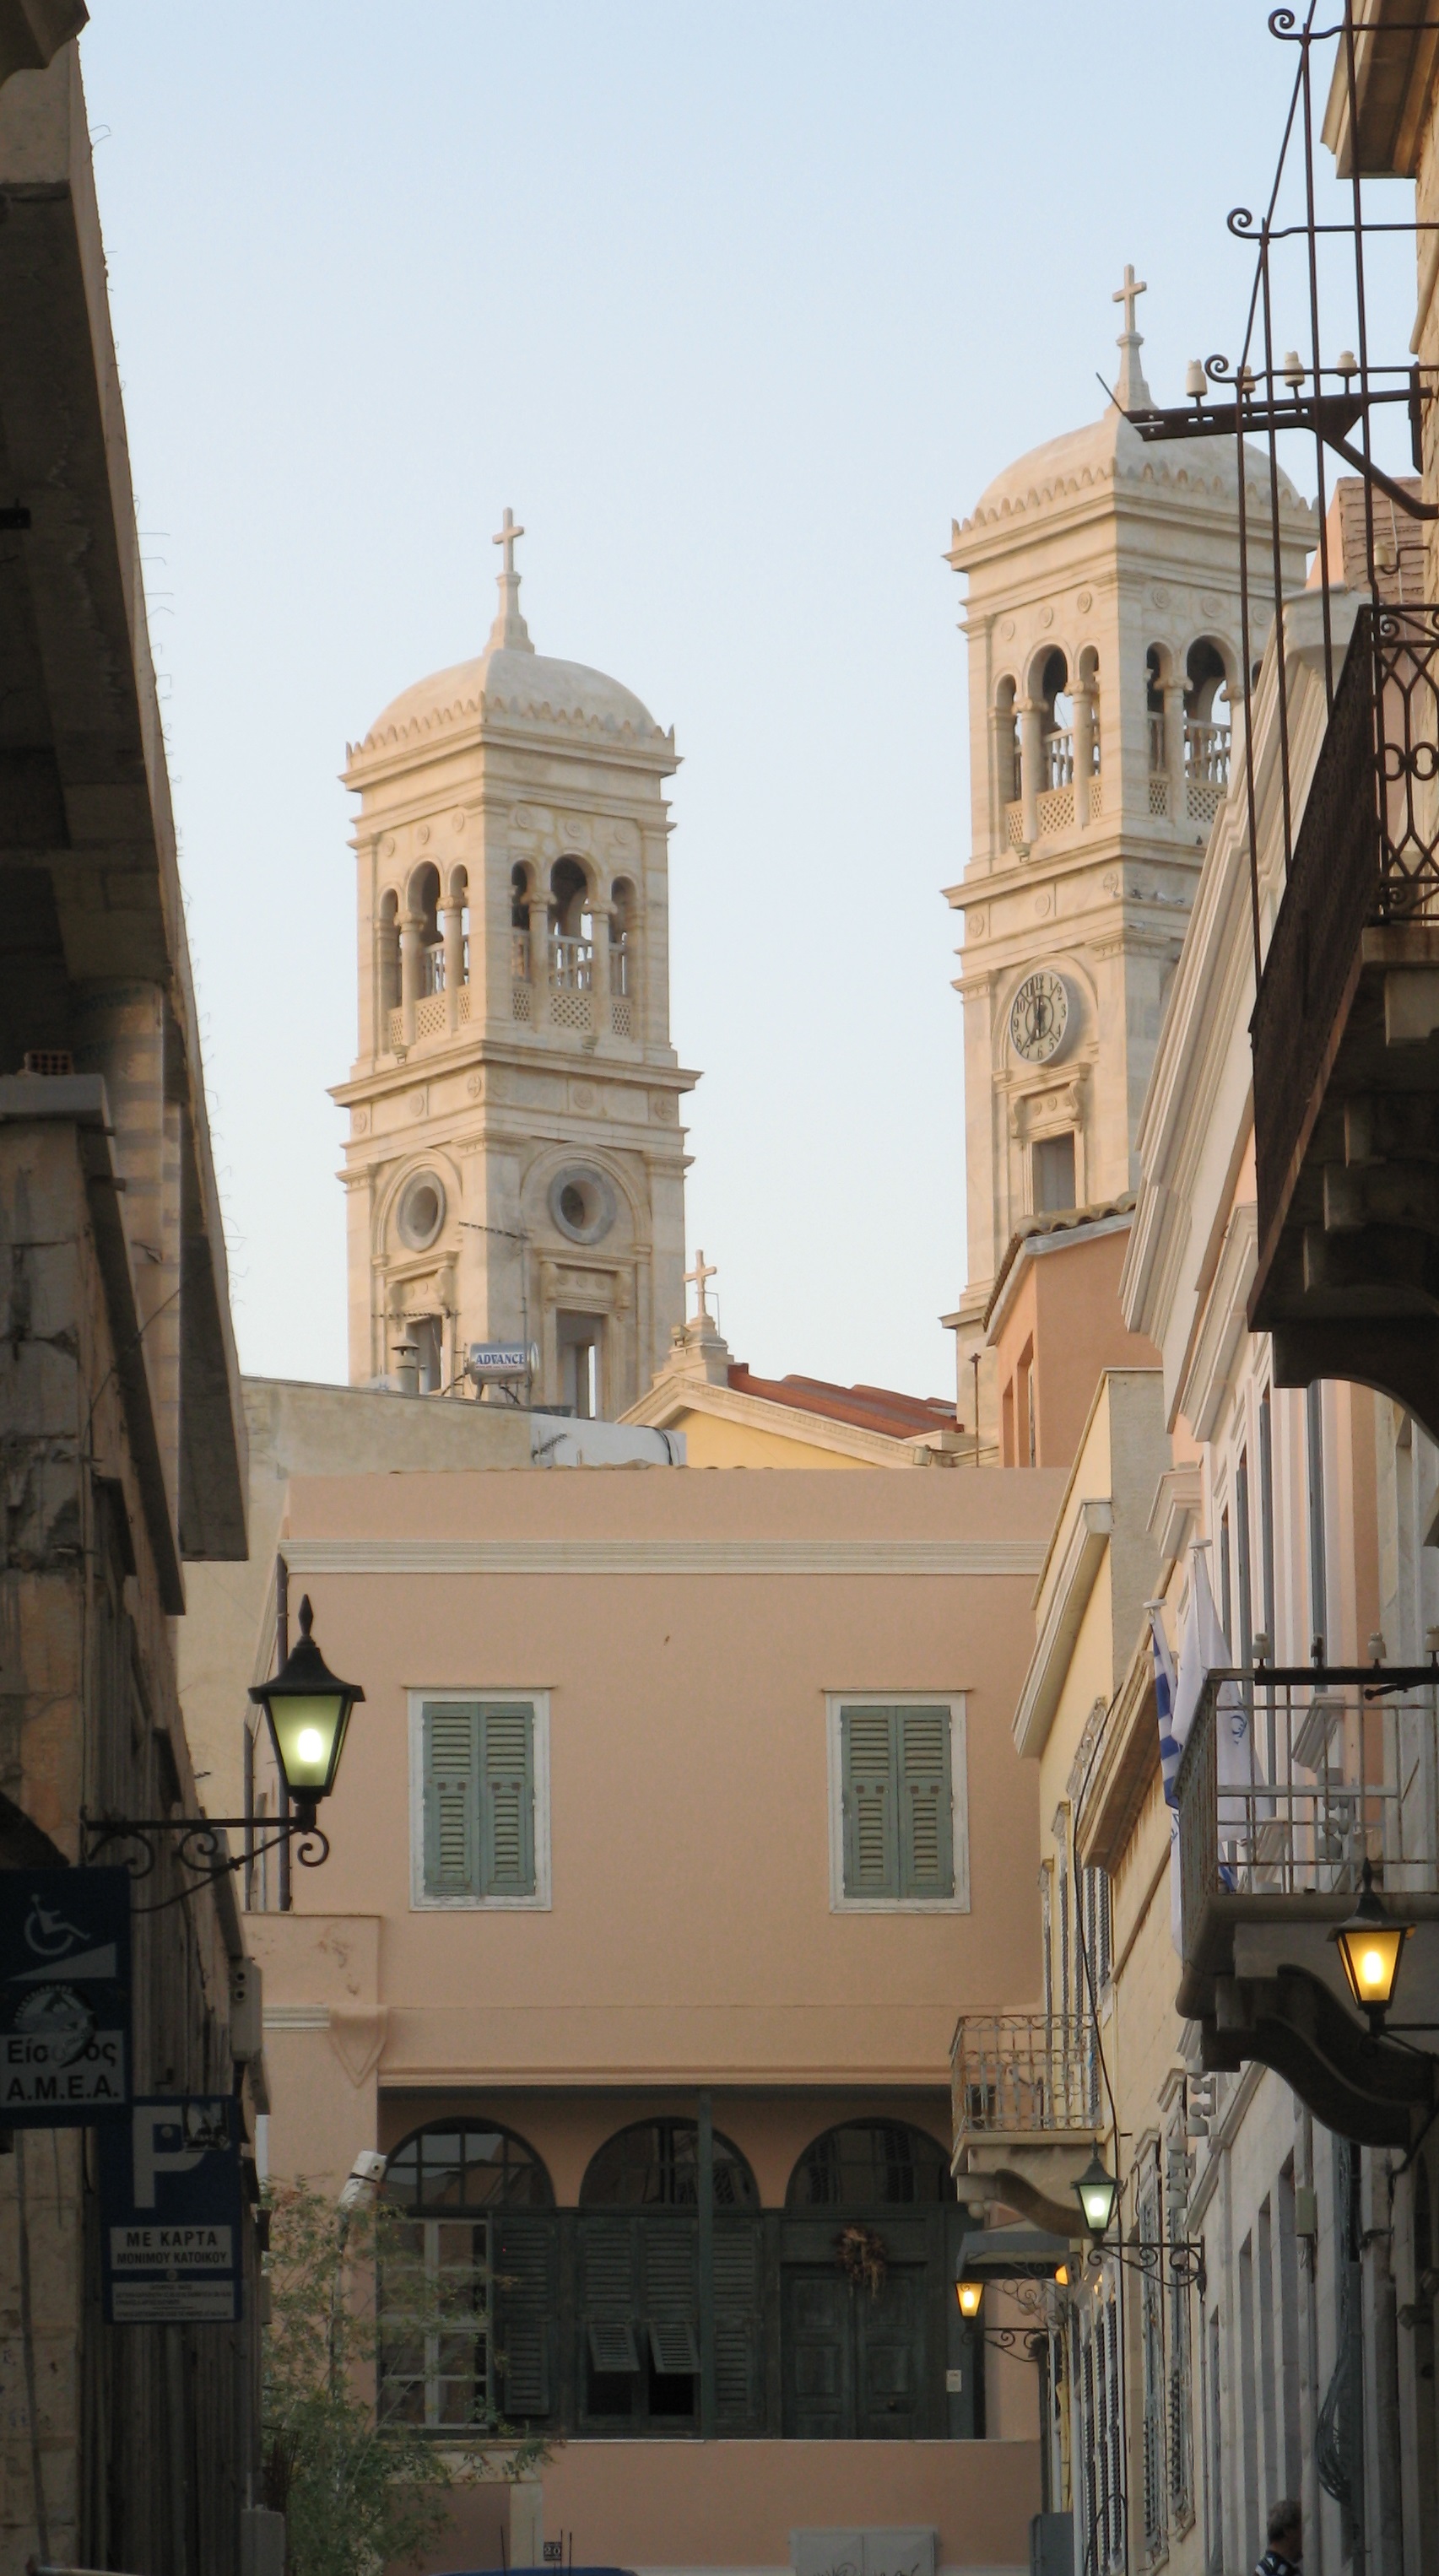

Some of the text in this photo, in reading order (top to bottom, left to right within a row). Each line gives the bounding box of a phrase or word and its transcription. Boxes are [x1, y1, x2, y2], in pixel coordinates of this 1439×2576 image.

[476, 1354, 524, 1364] ADVANCE
[133, 2105, 206, 2209] P
[127, 2230, 218, 2247] ΜΕ ΚΑΡΤΑ
[116, 2251, 227, 2265] ΜΟΝΙΜΟΥ ΚΑΤΟΙΚΟΥ
[544, 2546, 560, 2555] 20
